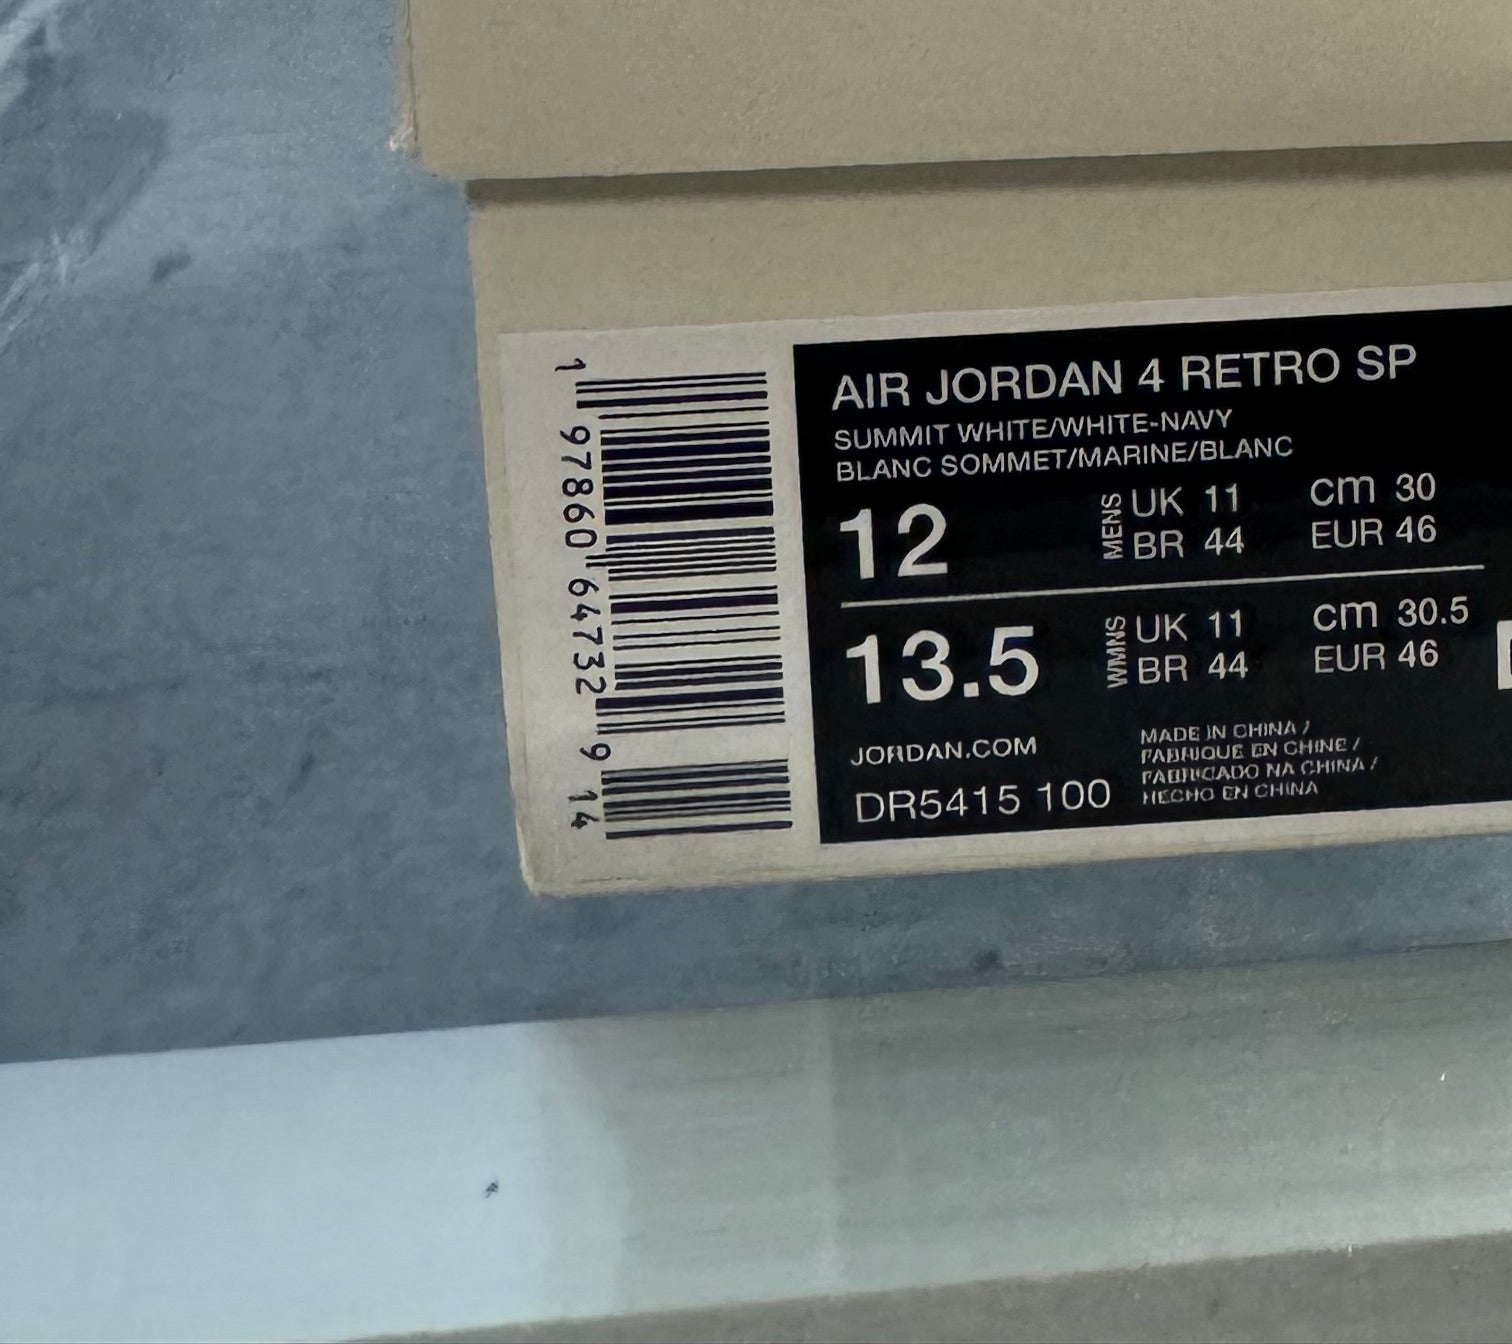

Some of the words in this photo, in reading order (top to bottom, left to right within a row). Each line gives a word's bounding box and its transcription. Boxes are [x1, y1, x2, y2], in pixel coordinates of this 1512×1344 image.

[554, 357, 587, 372] 1
[832, 372, 910, 411] AIR
[926, 359, 1122, 405] JORDAN
[1138, 358, 1165, 393] 4
[1181, 347, 1340, 391] RETRO
[1357, 343, 1417, 381] SP
[834, 424, 950, 451] SUMMIT
[957, 408, 1233, 444] WHITE/WHITE-NAVY
[836, 456, 932, 482] BLANC
[938, 435, 1293, 477] SOMMET/MARINE/BLANC
[559, 425, 598, 548] 97860
[1132, 486, 1184, 517] UK
[1205, 483, 1238, 513] 11
[1310, 475, 1375, 507] cm
[1395, 472, 1436, 502] 30
[839, 503, 948, 580] 12
[1100, 493, 1123, 560] MENS
[1133, 529, 1184, 560] BR
[1204, 525, 1245, 556] 44
[1311, 518, 1384, 549] EUR
[1395, 514, 1437, 544] 46
[567, 577, 607, 694] 64732
[1136, 613, 1188, 644] UK
[1208, 609, 1241, 638] 11
[1313, 601, 1378, 632] cm
[1397, 596, 1469, 627] 30.5
[846, 625, 1039, 705] 13.5
[1105, 615, 1128, 688] WMNS
[1138, 654, 1188, 685] BR
[1208, 651, 1249, 680] 44
[1314, 642, 1385, 673] EUR
[1397, 639, 1439, 668] 46
[579, 742, 612, 762] 9
[850, 736, 1037, 766] JORDAN.COM
[1140, 726, 1200, 745] MADE
[1207, 725, 1226, 740] IN
[1233, 720, 1296, 739] CHINA
[1283, 737, 1346, 756] CHINE
[1266, 762, 1295, 778] NA
[1300, 757, 1365, 775] CHINA
[567, 790, 601, 830] 14
[855, 784, 1021, 823] DR5415
[1037, 778, 1111, 812] 100
[1143, 788, 1215, 805] HECHO
[1254, 781, 1318, 797] CHINA
